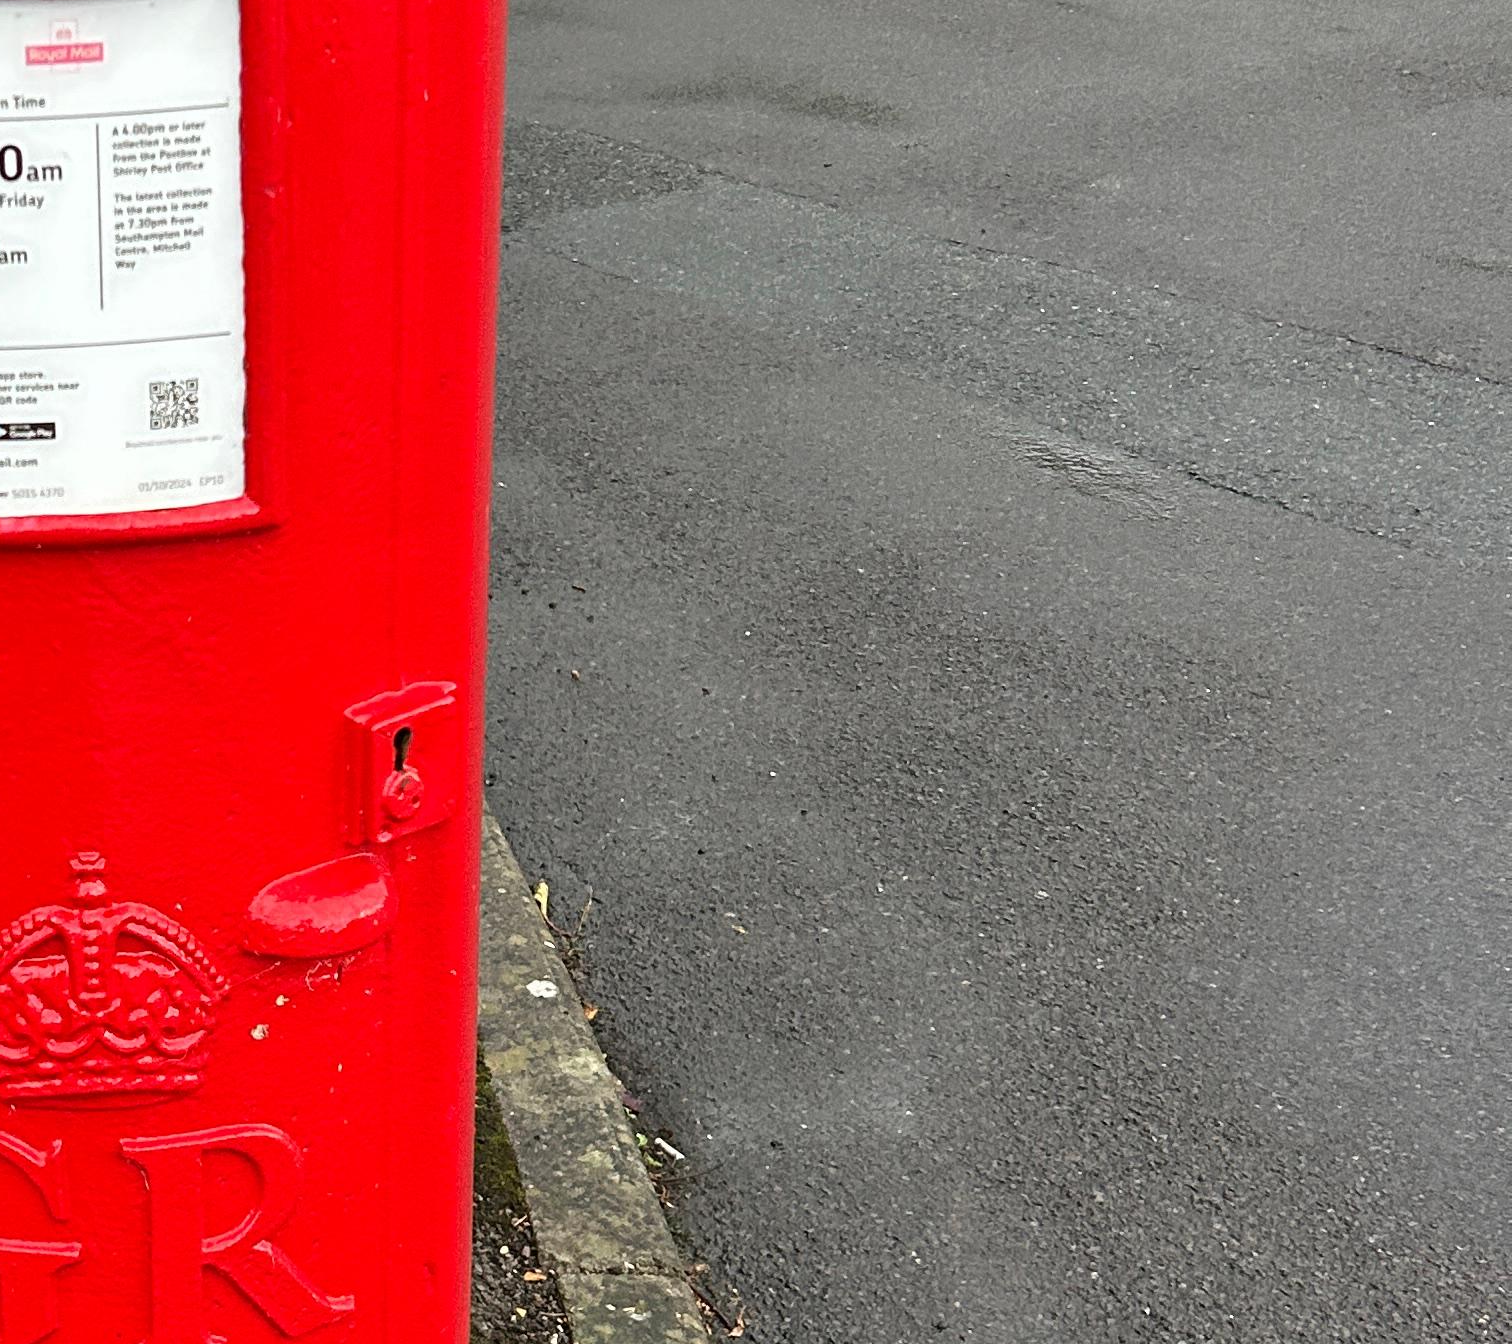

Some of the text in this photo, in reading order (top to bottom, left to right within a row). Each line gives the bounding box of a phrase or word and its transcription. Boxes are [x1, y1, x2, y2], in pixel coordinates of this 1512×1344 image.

[28, 45, 100, 63] Royal Mail
[13, 94, 46, 108] Time
[182, 121, 205, 131] later
[112, 138, 159, 149] collection
[174, 135, 200, 144] made
[113, 153, 136, 163] from
[140, 152, 156, 161] the
[113, 161, 203, 177] Shirley Post Office
[0, 192, 44, 209] Friday
[114, 187, 212, 203] The latest collection
[126, 206, 142, 215] the
[146, 205, 167, 213] area
[182, 201, 208, 210] made
[171, 215, 194, 225] from
[114, 226, 204, 244] Southampton Mail
[115, 261, 136, 271] Way
[15, 383, 54, 392] services
[58, 382, 80, 391] near
[15, 396, 38, 405] code
